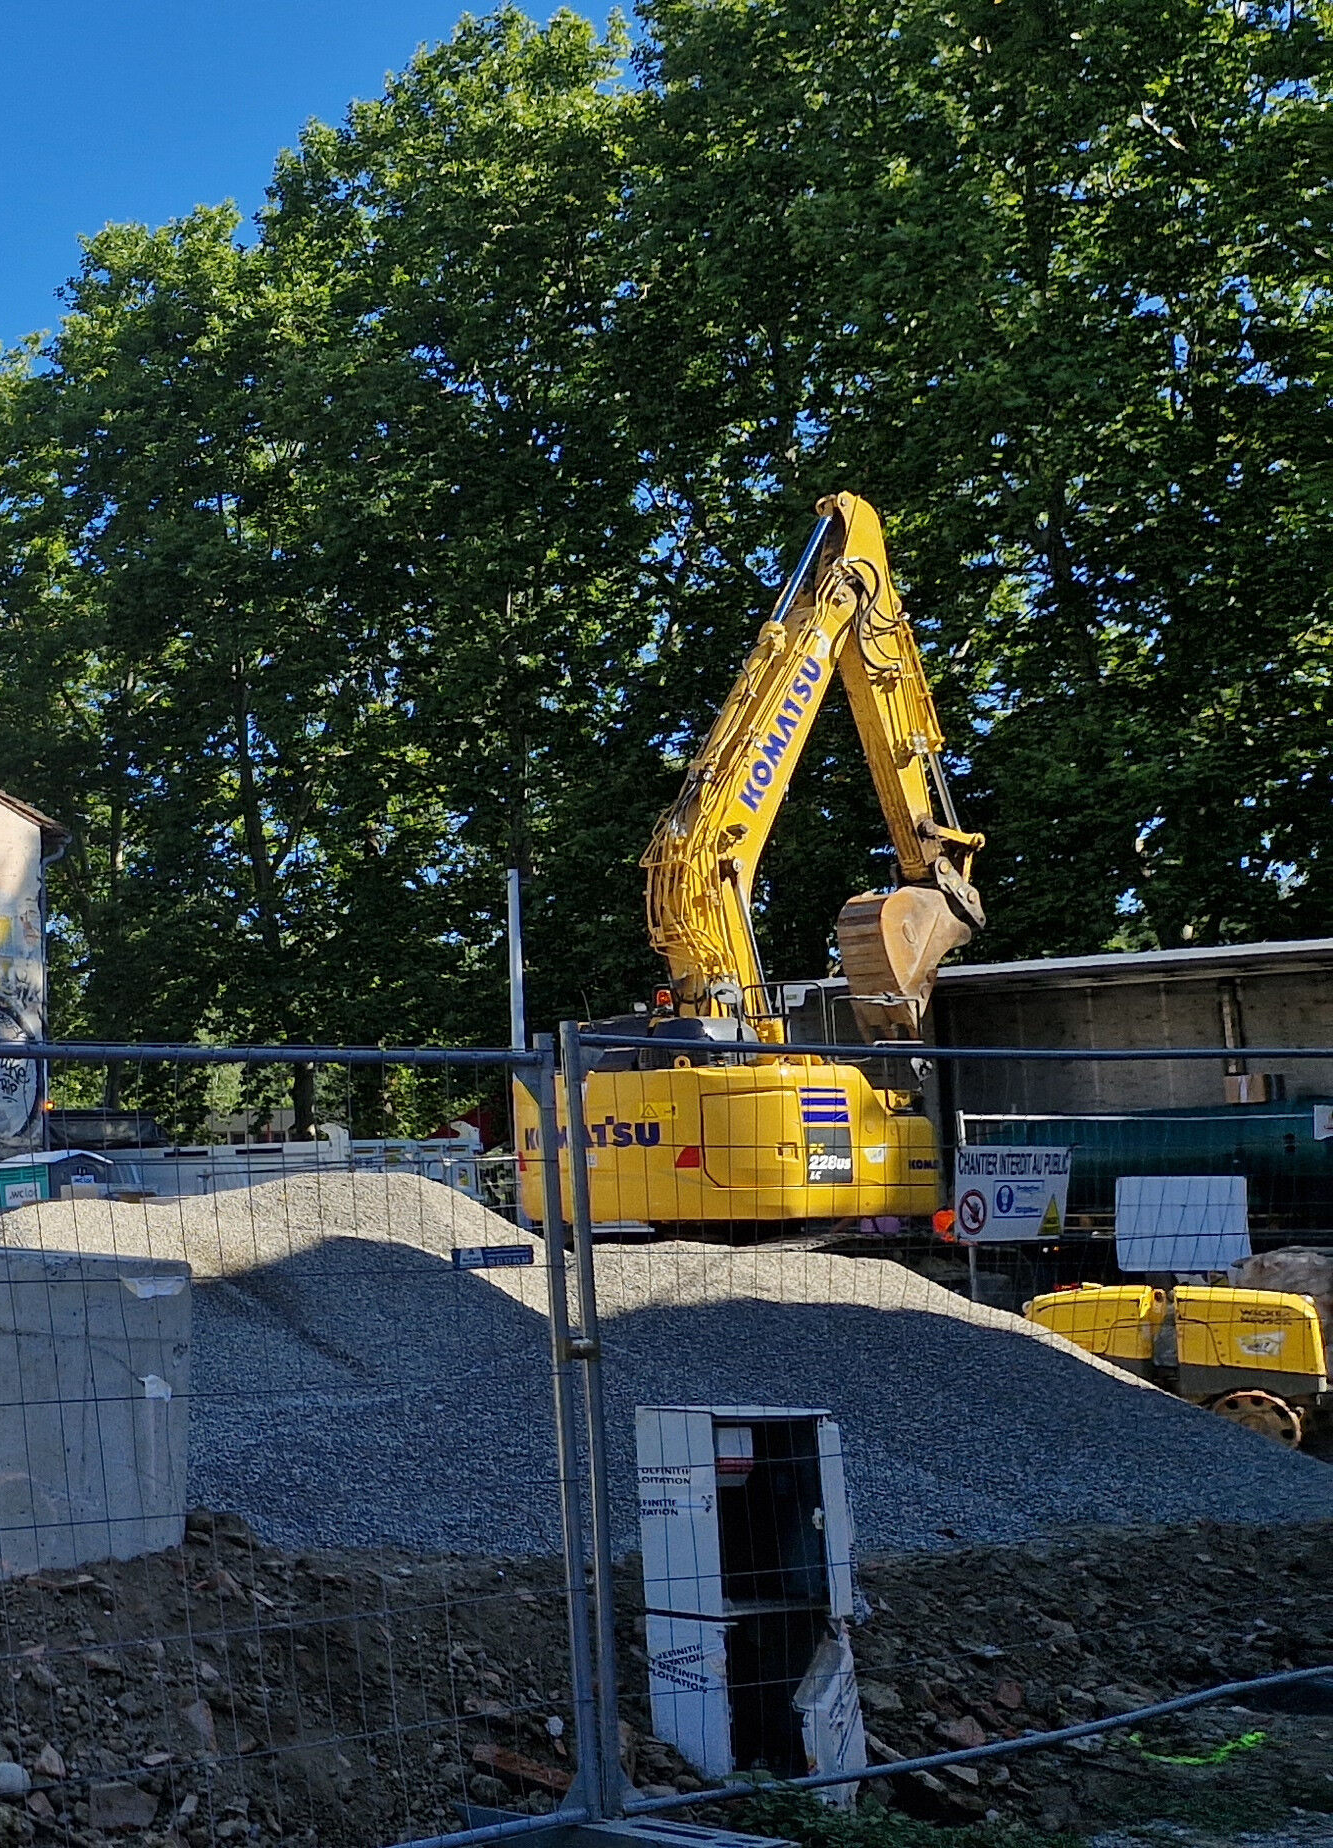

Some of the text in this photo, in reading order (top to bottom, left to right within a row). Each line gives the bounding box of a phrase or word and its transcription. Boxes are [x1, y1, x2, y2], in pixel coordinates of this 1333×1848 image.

[739, 656, 822, 813] KOMATSU
[525, 1116, 661, 1150] KMATSU
[958, 1152, 998, 1176] CHANTIER
[999, 1152, 1032, 1176] INTERDIT
[1044, 1152, 1070, 1176] PUBLIC
